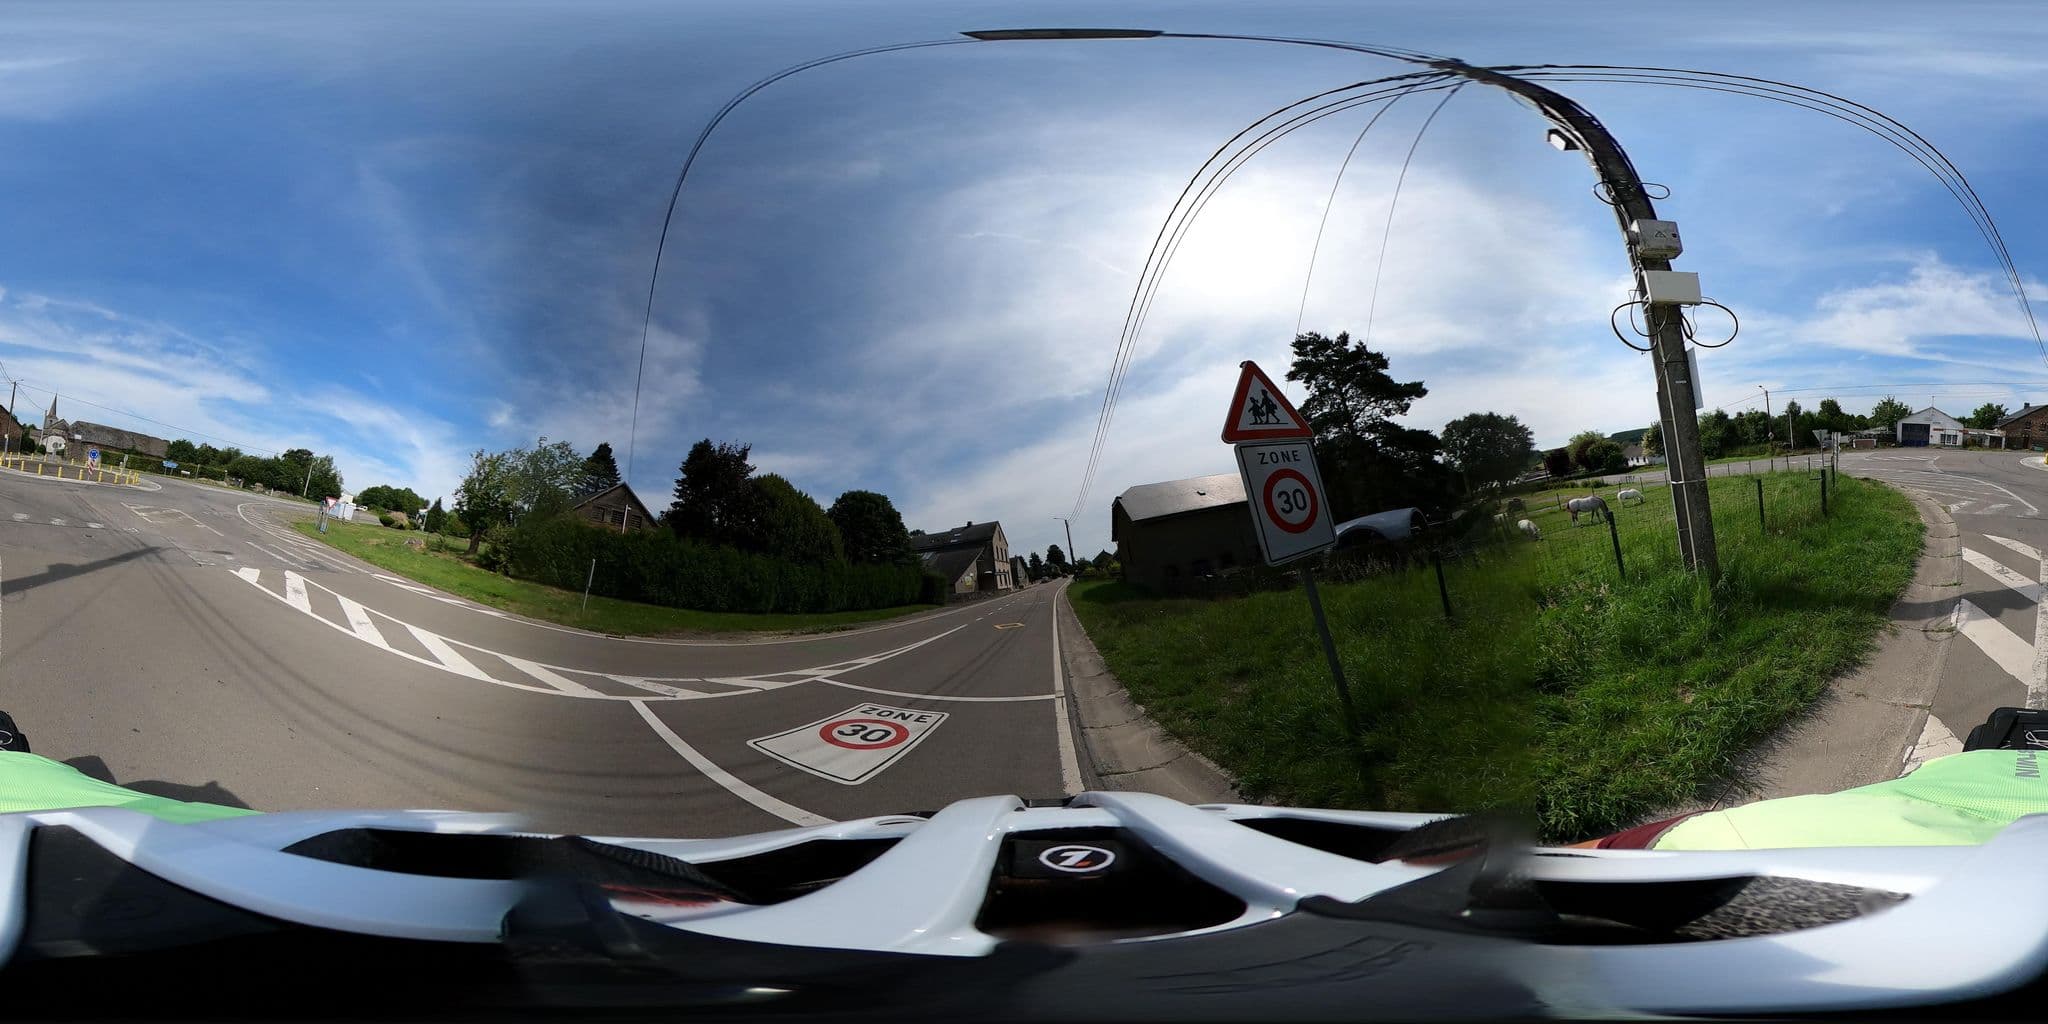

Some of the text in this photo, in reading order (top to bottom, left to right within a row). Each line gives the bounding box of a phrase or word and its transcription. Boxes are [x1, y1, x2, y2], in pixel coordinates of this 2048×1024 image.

[1257, 450, 1301, 465] ZONE
[1277, 488, 1307, 514] 30
[860, 707, 933, 723] ZONE
[837, 724, 892, 742] 30
